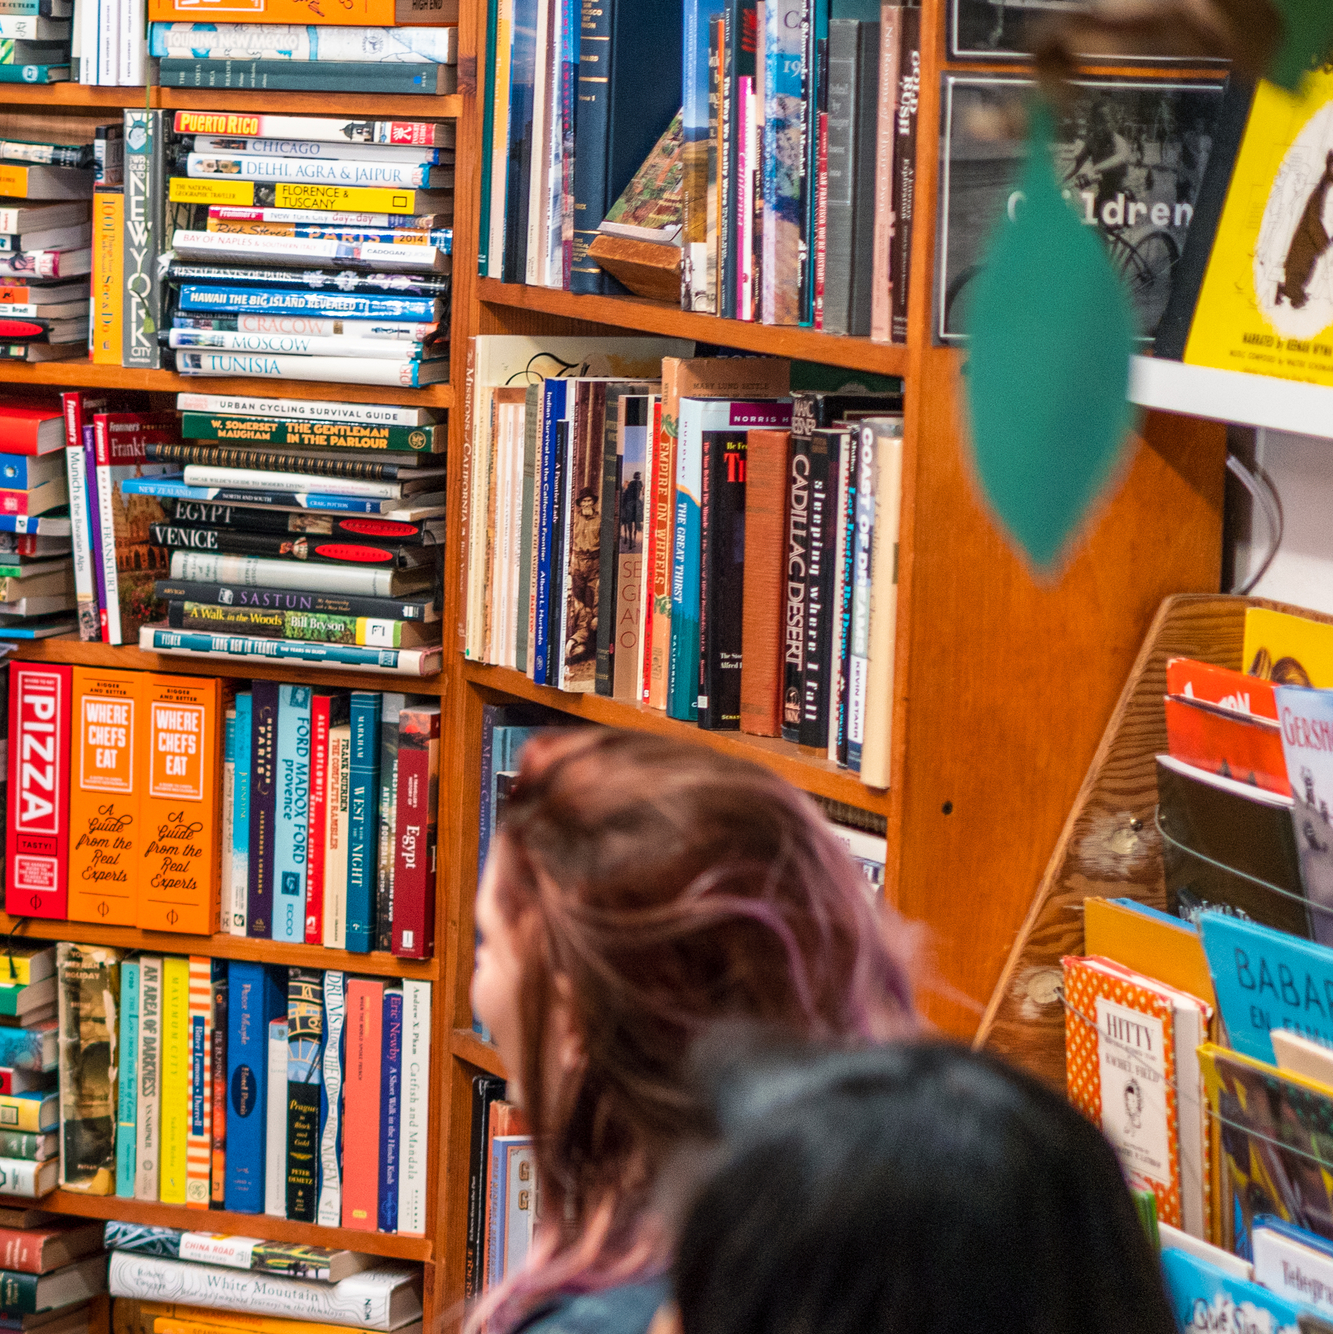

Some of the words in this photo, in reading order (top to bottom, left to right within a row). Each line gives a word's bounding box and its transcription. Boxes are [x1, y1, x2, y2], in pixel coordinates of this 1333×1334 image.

[180, 113, 225, 133] PUERTO
[228, 115, 258, 134] RICO
[252, 141, 320, 155] CHICAGO
[247, 157, 294, 177] DELHI,
[296, 161, 337, 179] AGRA
[341, 164, 351, 180] &
[355, 165, 401, 182] JAIPUR
[283, 186, 339, 198] FLORENCE
[343, 187, 348, 198] &
[283, 197, 335, 209] TUSCANY
[400, 234, 423, 243] 2014
[243, 316, 324, 334] CRACOW
[232, 336, 311, 351] MOSCOW
[210, 355, 280, 374] TUNISIA
[220, 401, 254, 412] URBAN
[260, 403, 305, 415] CYCLING
[310, 406, 361, 418] SURVIVAL
[365, 409, 399, 421] GUIDE
[211, 420, 224, 430] W.
[227, 421, 278, 432] SOMERSET
[217, 430, 270, 440] MAUGHAM
[285, 422, 311, 435] THE
[314, 423, 389, 438] GENTLEMAN
[286, 432, 299, 445] IN
[302, 433, 325, 446] THE
[328, 434, 387, 449] PARLOUR
[175, 503, 234, 524] EGYPT
[677, 503, 687, 524] THE
[789, 455, 808, 575] CADILLAC
[155, 528, 218, 548] VENICE
[675, 527, 686, 561] GREAT
[673, 563, 685, 605] THIRST
[240, 592, 312, 608] SASTUN
[191, 609, 198, 621] A
[201, 609, 225, 623] Walk
[226, 611, 235, 623] in
[236, 611, 248, 624] the
[251, 612, 282, 626] Woods
[291, 616, 308, 630] Bill
[311, 617, 344, 632] Bryson
[785, 579, 804, 671] DESERT
[854, 661, 863, 694] KEVIN
[156, 710, 199, 731] WHERE
[853, 698, 862, 741] STARR
[158, 733, 195, 754] CHEFS
[297, 717, 309, 757] FORD
[22, 696, 55, 822] PIZZA
[167, 756, 187, 775] EAT
[283, 759, 293, 820] provence
[295, 762, 307, 814] MADOX
[168, 812, 183, 822] A
[158, 823, 203, 840] Guide
[293, 817, 306, 864] FORD
[22, 841, 51, 849] TASTY!
[145, 842, 181, 857] from
[183, 842, 202, 858] the
[402, 826, 420, 869] Egypt
[161, 858, 189, 872] Real
[151, 875, 198, 891] Experts
[390, 997, 401, 1021] Eric
[1106, 1013, 1154, 1051] HITTY
[387, 1024, 399, 1063] Newby
[207, 1275, 247, 1294] White
[254, 1280, 319, 1301] Mountain
